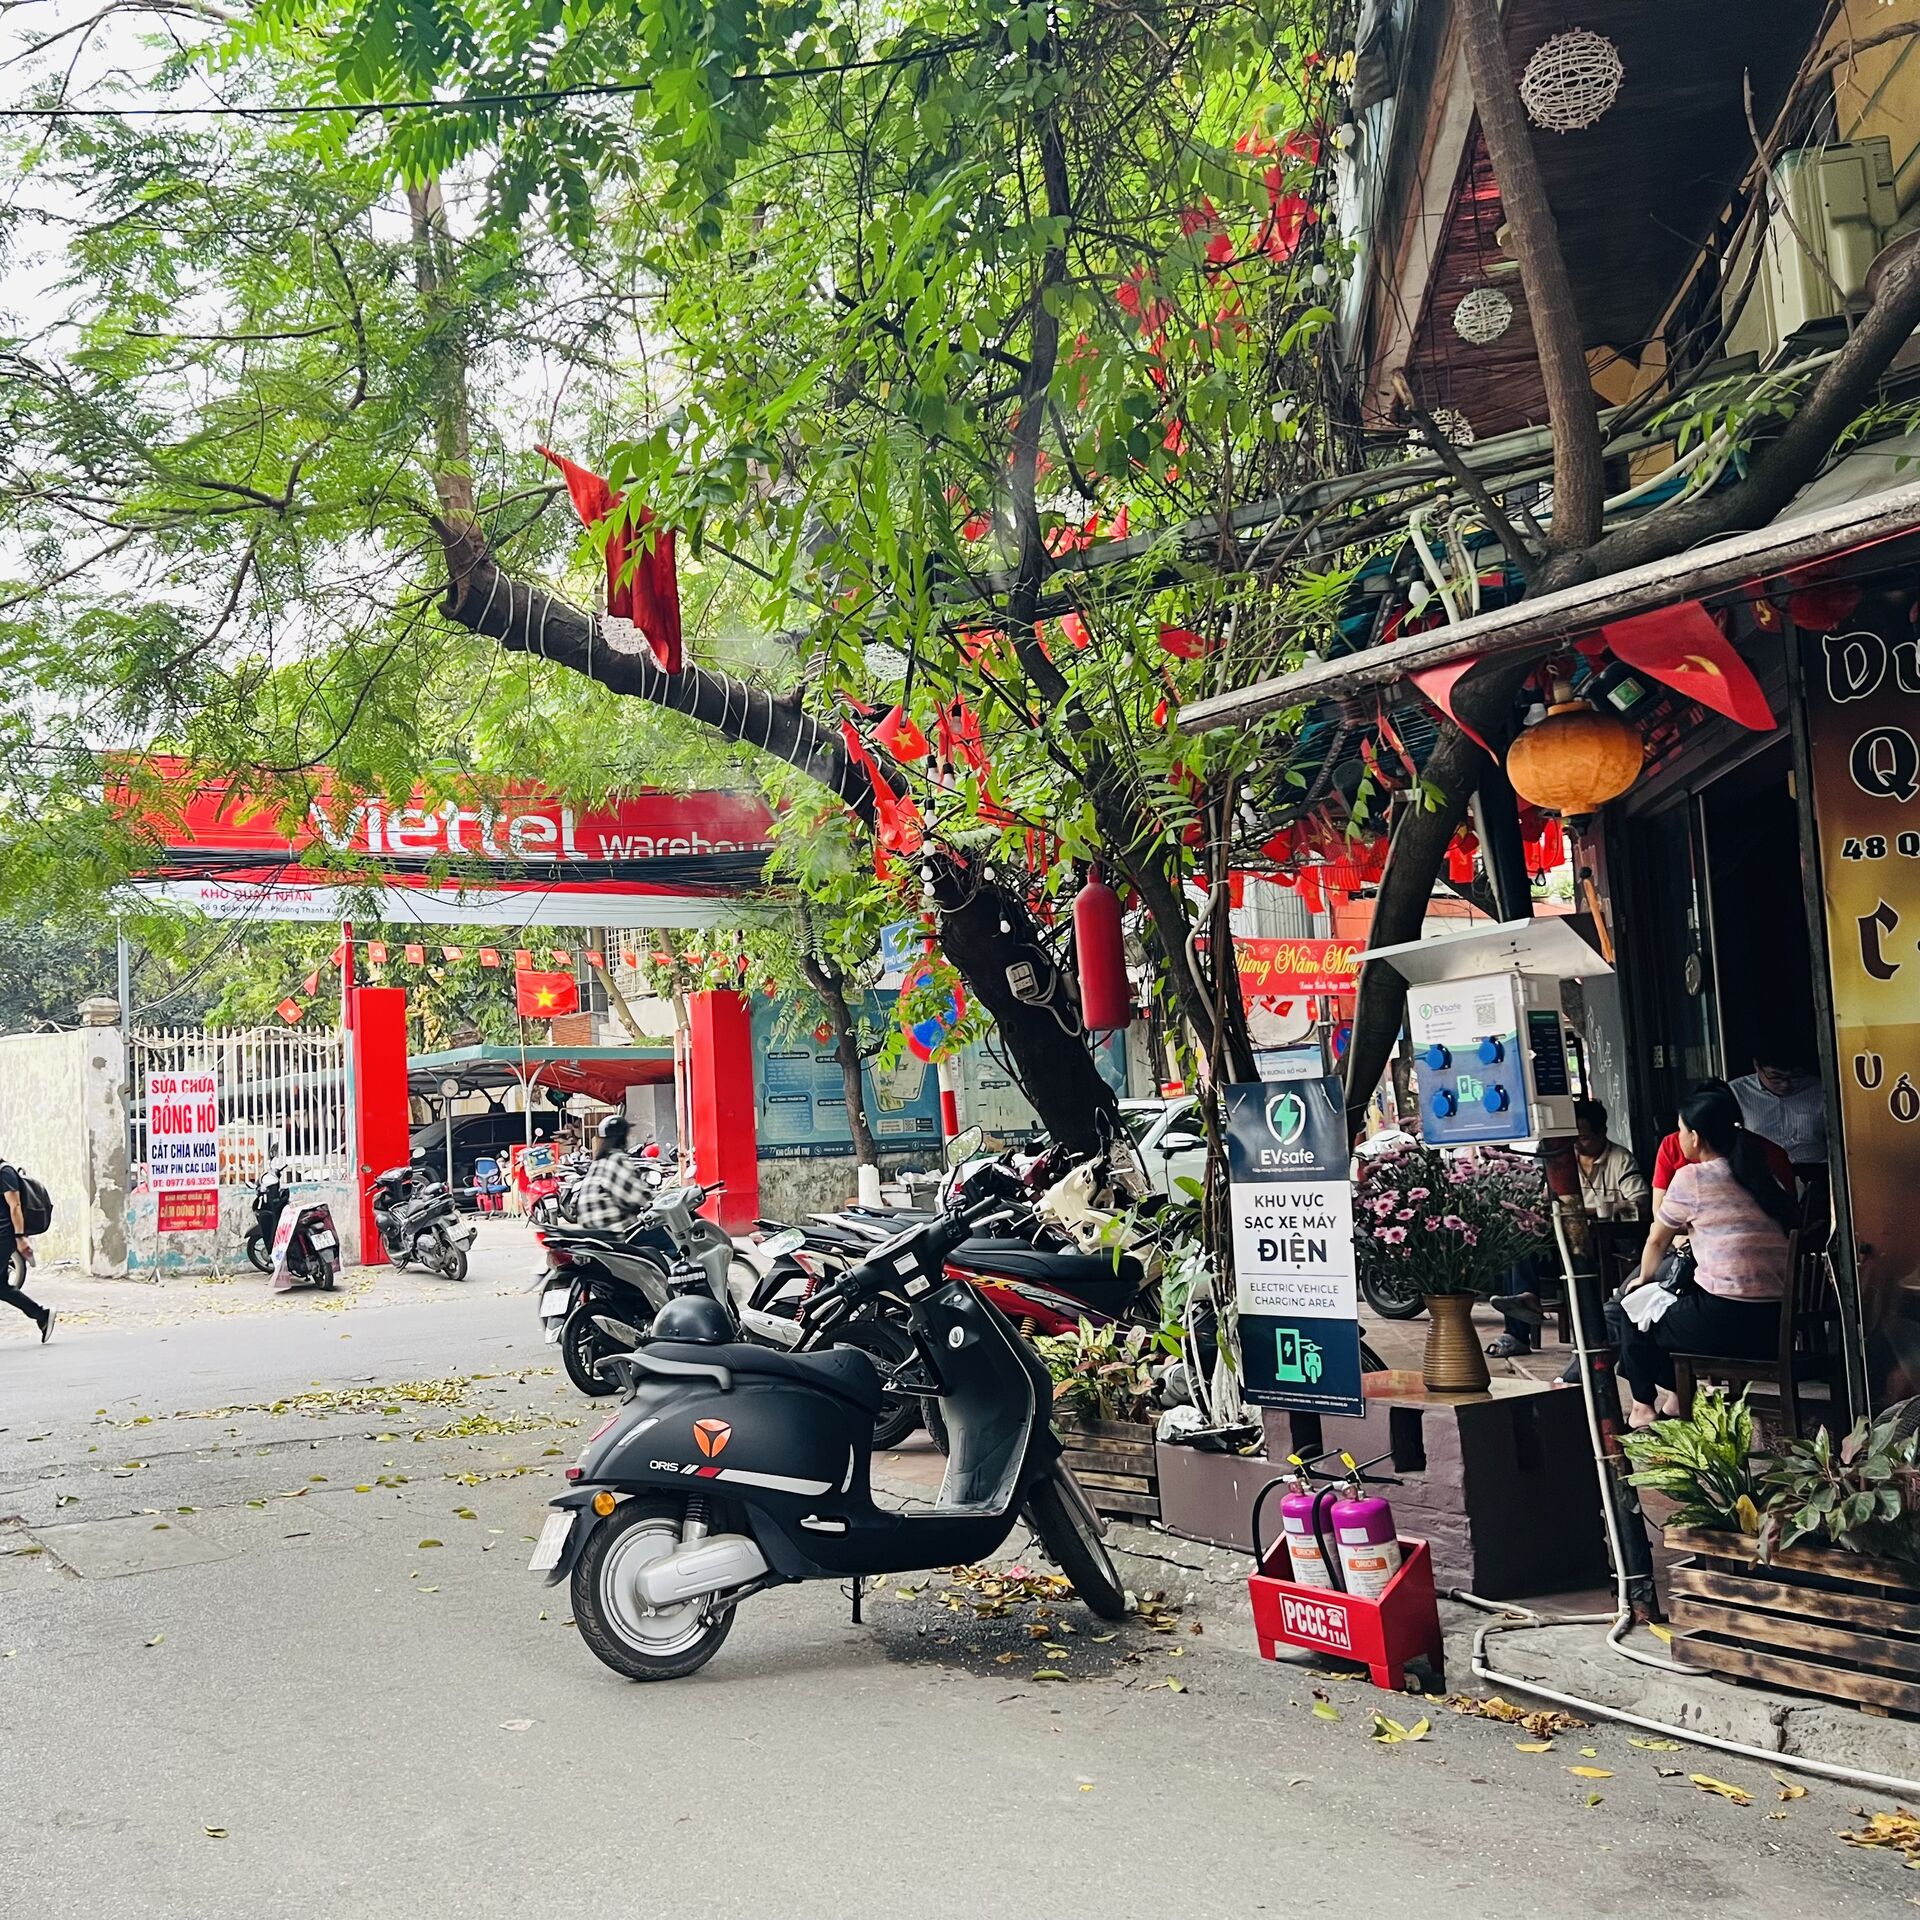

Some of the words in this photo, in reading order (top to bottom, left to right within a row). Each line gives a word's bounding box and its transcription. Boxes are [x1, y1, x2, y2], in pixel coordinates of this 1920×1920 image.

[1841, 835, 1887, 861] 48
[201, 888, 229, 899] KHO
[1274, 943, 1320, 974] Năm
[1433, 1002, 1462, 1015] EVsafe
[152, 1075, 177, 1093] SỬA
[181, 1075, 215, 1093] CHỮA
[152, 1095, 192, 1134] ĐỒNG
[197, 1094, 216, 1133] HỒ
[1260, 1148, 1315, 1166] EVsafe
[151, 1164, 169, 1175] THAY
[170, 1163, 184, 1174] PIN
[1254, 1194, 1286, 1208] KHU
[1291, 1192, 1324, 1211] VỰC
[1244, 1216, 1274, 1232] SẠC
[1278, 1216, 1298, 1229] XE
[1303, 1211, 1337, 1229] MÁY
[1257, 1232, 1328, 1270] ĐIỆN
[1250, 1282, 1295, 1293] ELECTRIC
[1297, 1283, 1340, 1294] VEHICLE
[1254, 1296, 1306, 1307] CHARGING
[1308, 1297, 1336, 1308] AREA
[649, 1459, 679, 1472] ORIS
[1354, 1559, 1378, 1568] ORION
[1283, 1598, 1328, 1639] PCCC
[1327, 1628, 1349, 1646] 114
